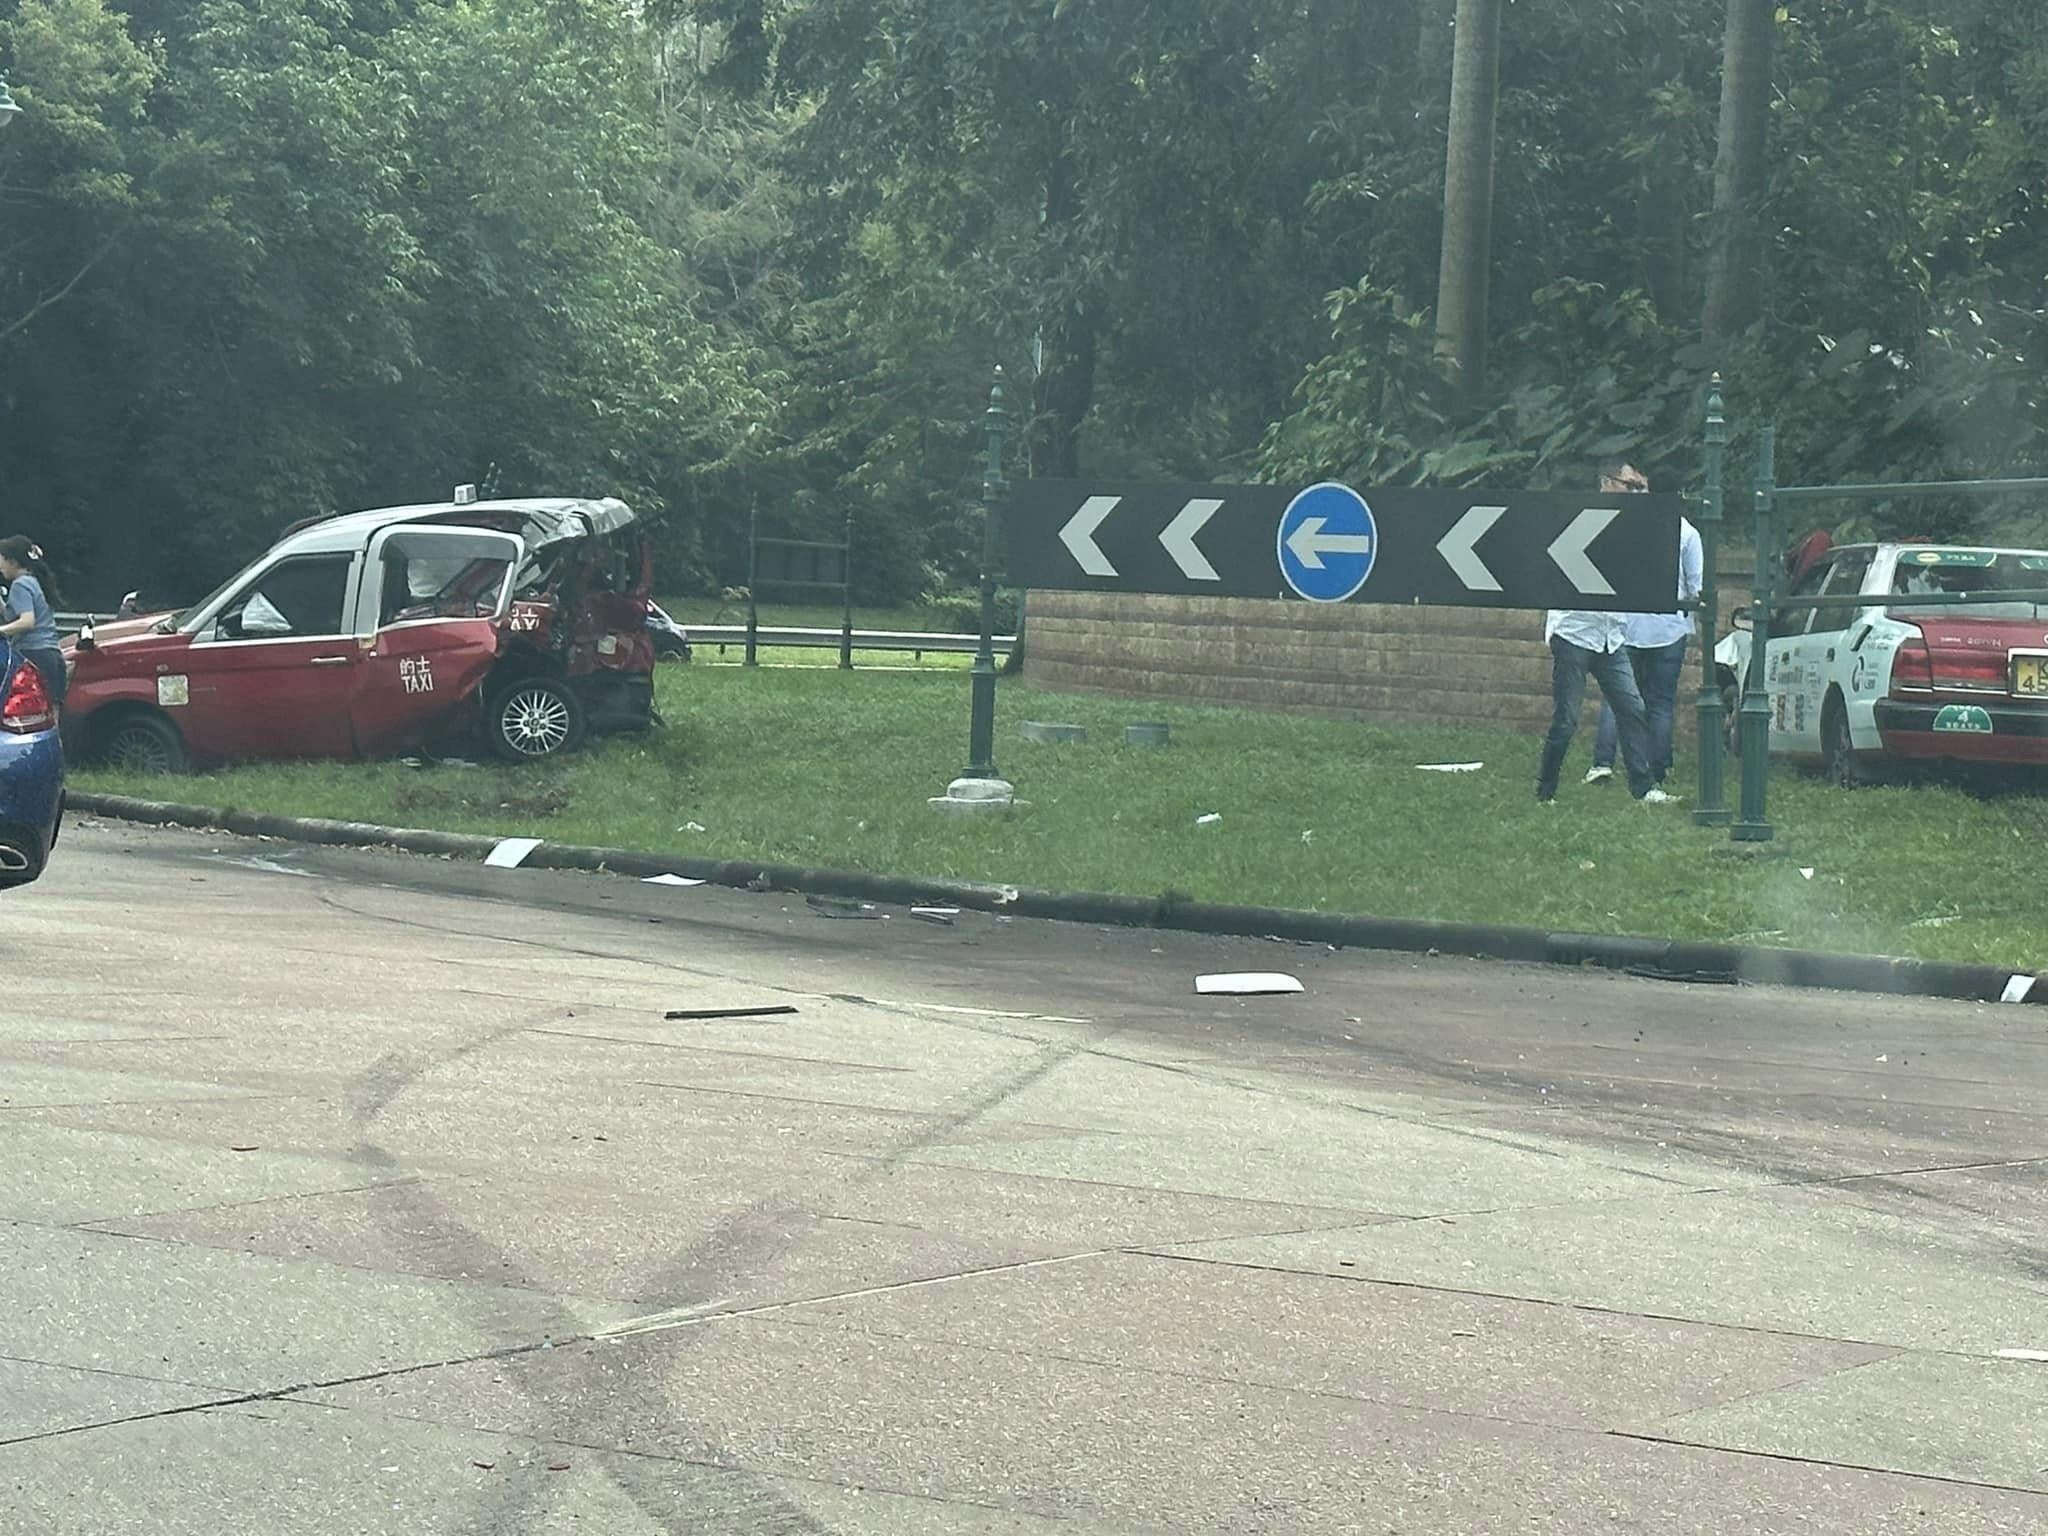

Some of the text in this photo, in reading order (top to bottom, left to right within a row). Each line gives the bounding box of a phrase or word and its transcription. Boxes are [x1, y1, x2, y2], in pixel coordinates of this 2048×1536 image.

[400, 655, 431, 674] 的士
[401, 673, 434, 693] TAXI
[1958, 710, 1969, 722] 4
